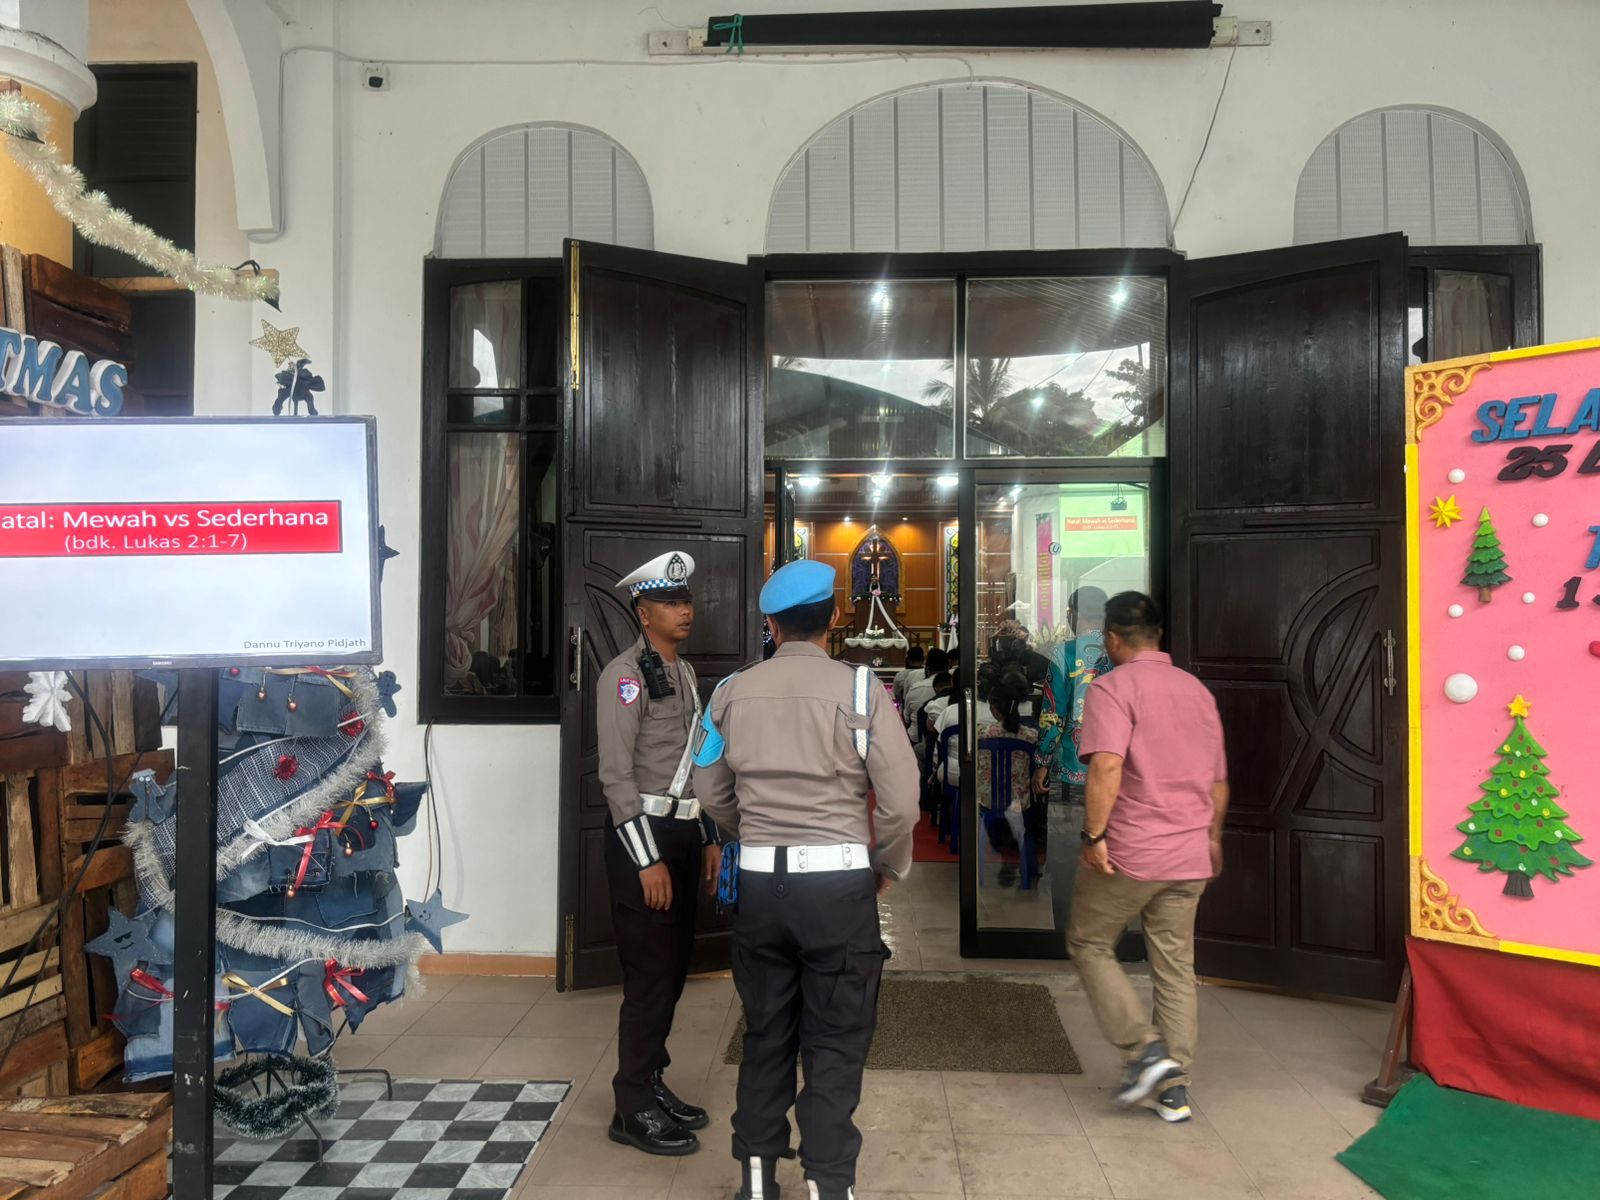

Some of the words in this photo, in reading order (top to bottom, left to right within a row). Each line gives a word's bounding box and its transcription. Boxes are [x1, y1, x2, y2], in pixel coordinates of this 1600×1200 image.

[1497, 444, 1573, 481] 25
[1, 511, 55, 529] atal:
[63, 510, 157, 528] Mewah
[163, 513, 191, 528] vs
[196, 508, 329, 528] Sederhana
[64, 534, 116, 552] (bdk.
[124, 534, 181, 549] Lukas
[187, 533, 248, 551] 2:1-7)
[243, 641, 281, 649] Dannu
[283, 640, 325, 650] Triyano
[327, 638, 367, 649] Pidjath
